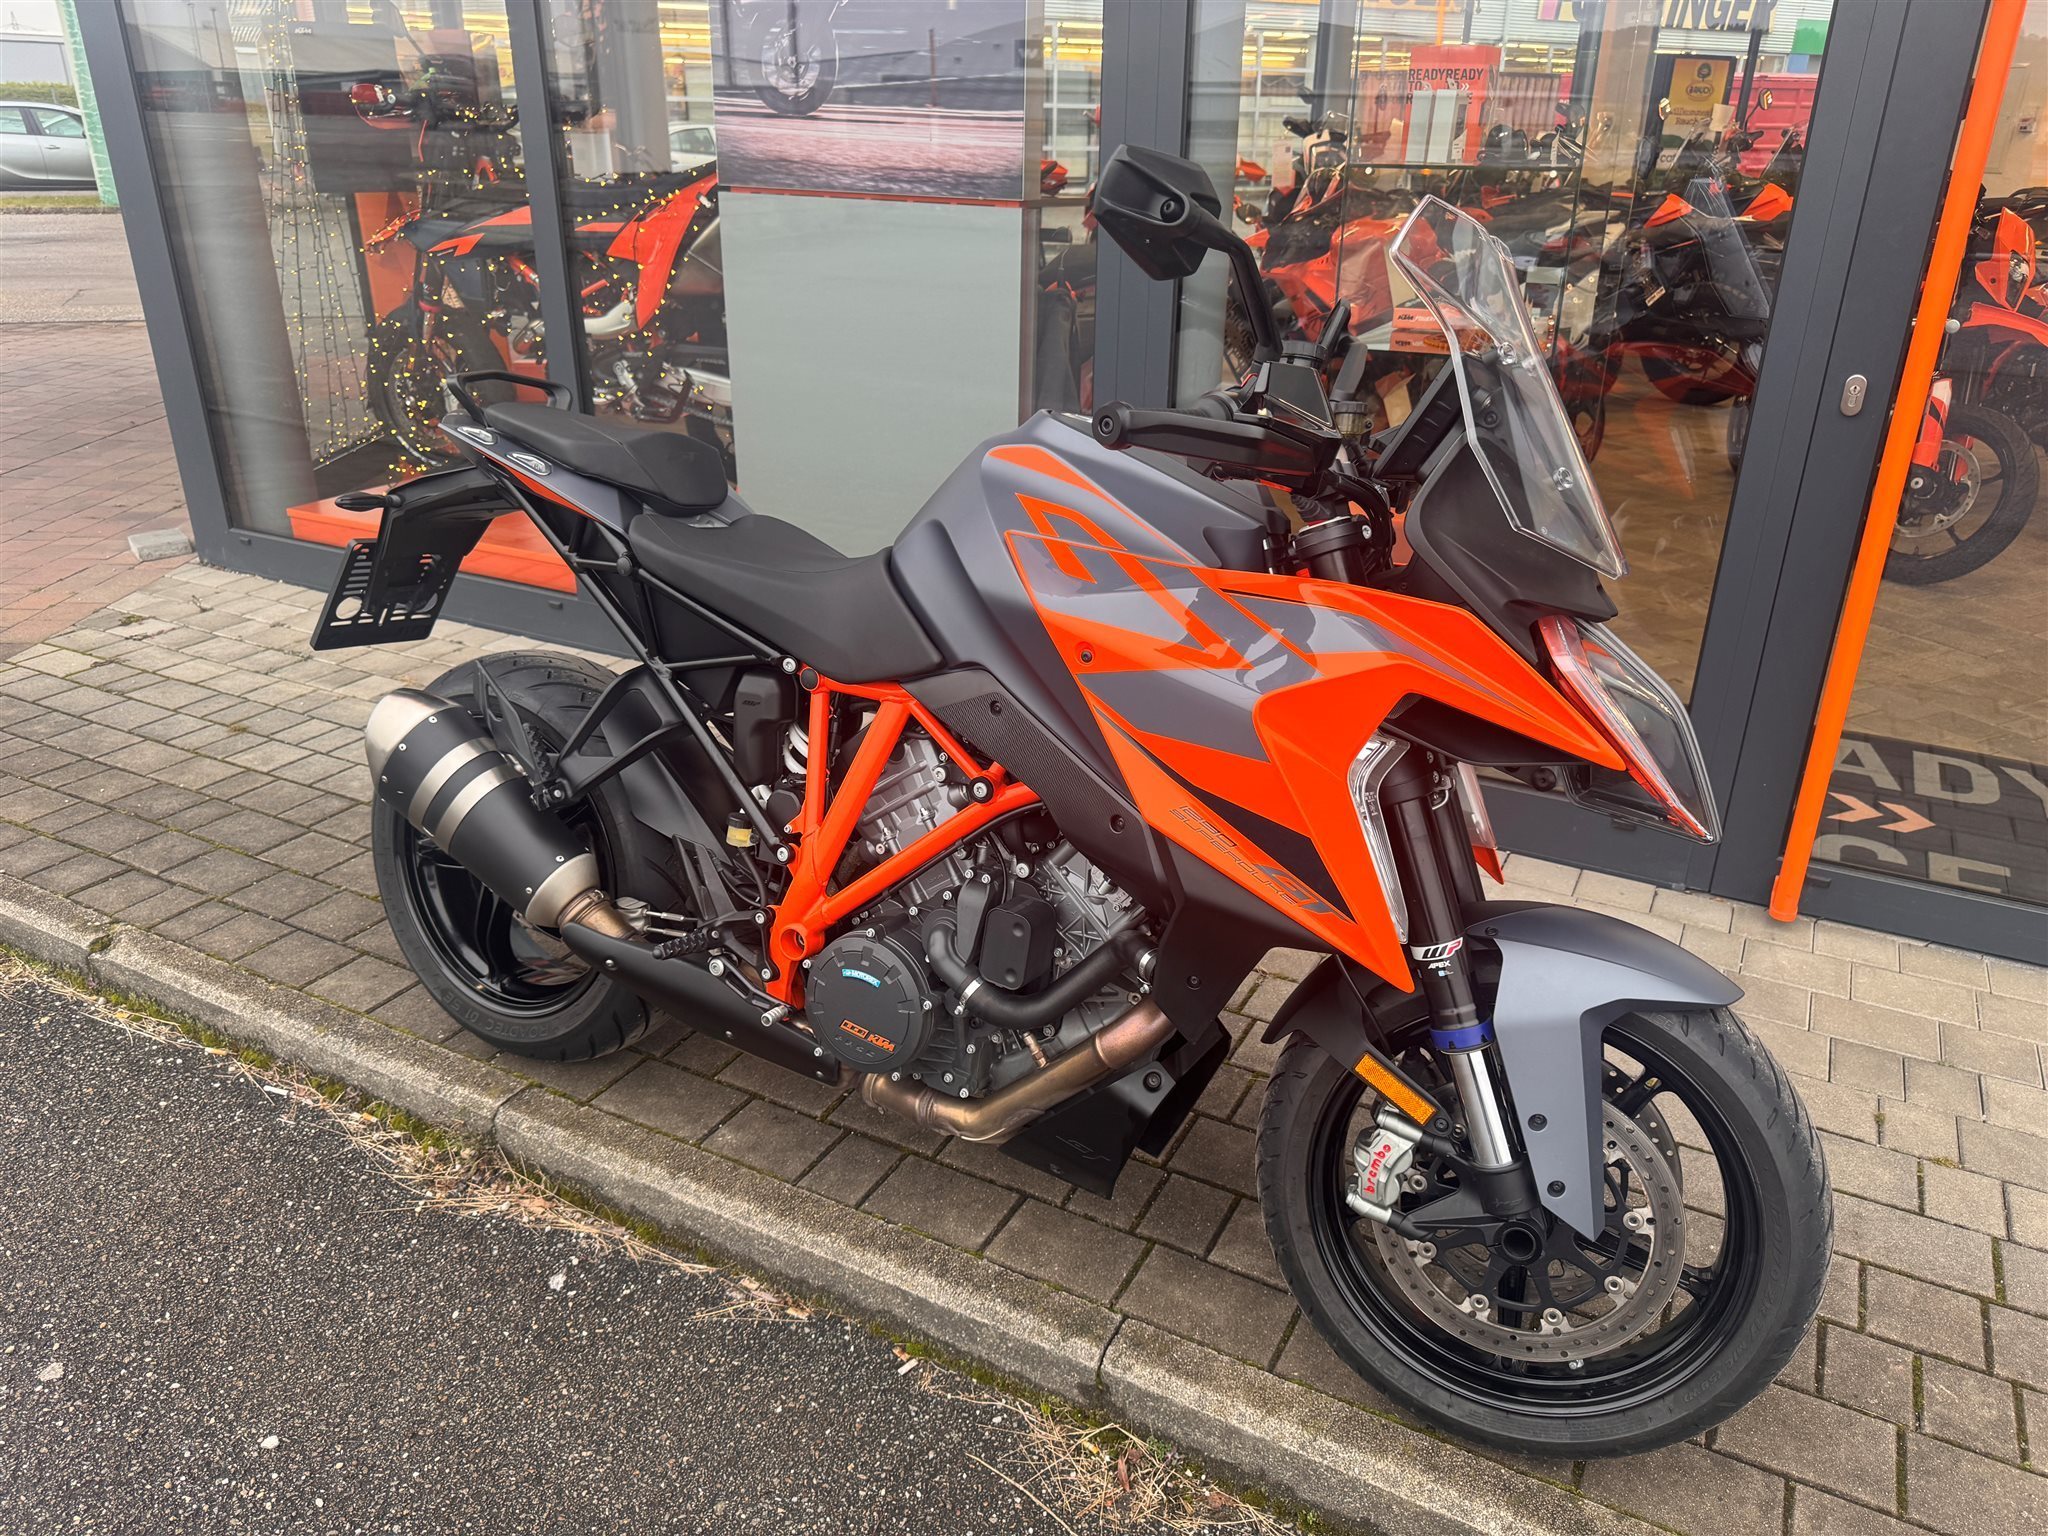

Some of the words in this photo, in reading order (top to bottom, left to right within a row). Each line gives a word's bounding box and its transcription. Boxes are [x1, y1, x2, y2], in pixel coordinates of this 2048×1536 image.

[1832, 738, 2048, 819] ADY
[1428, 960, 1452, 970] APEX
[867, 1033, 896, 1053] KTM
